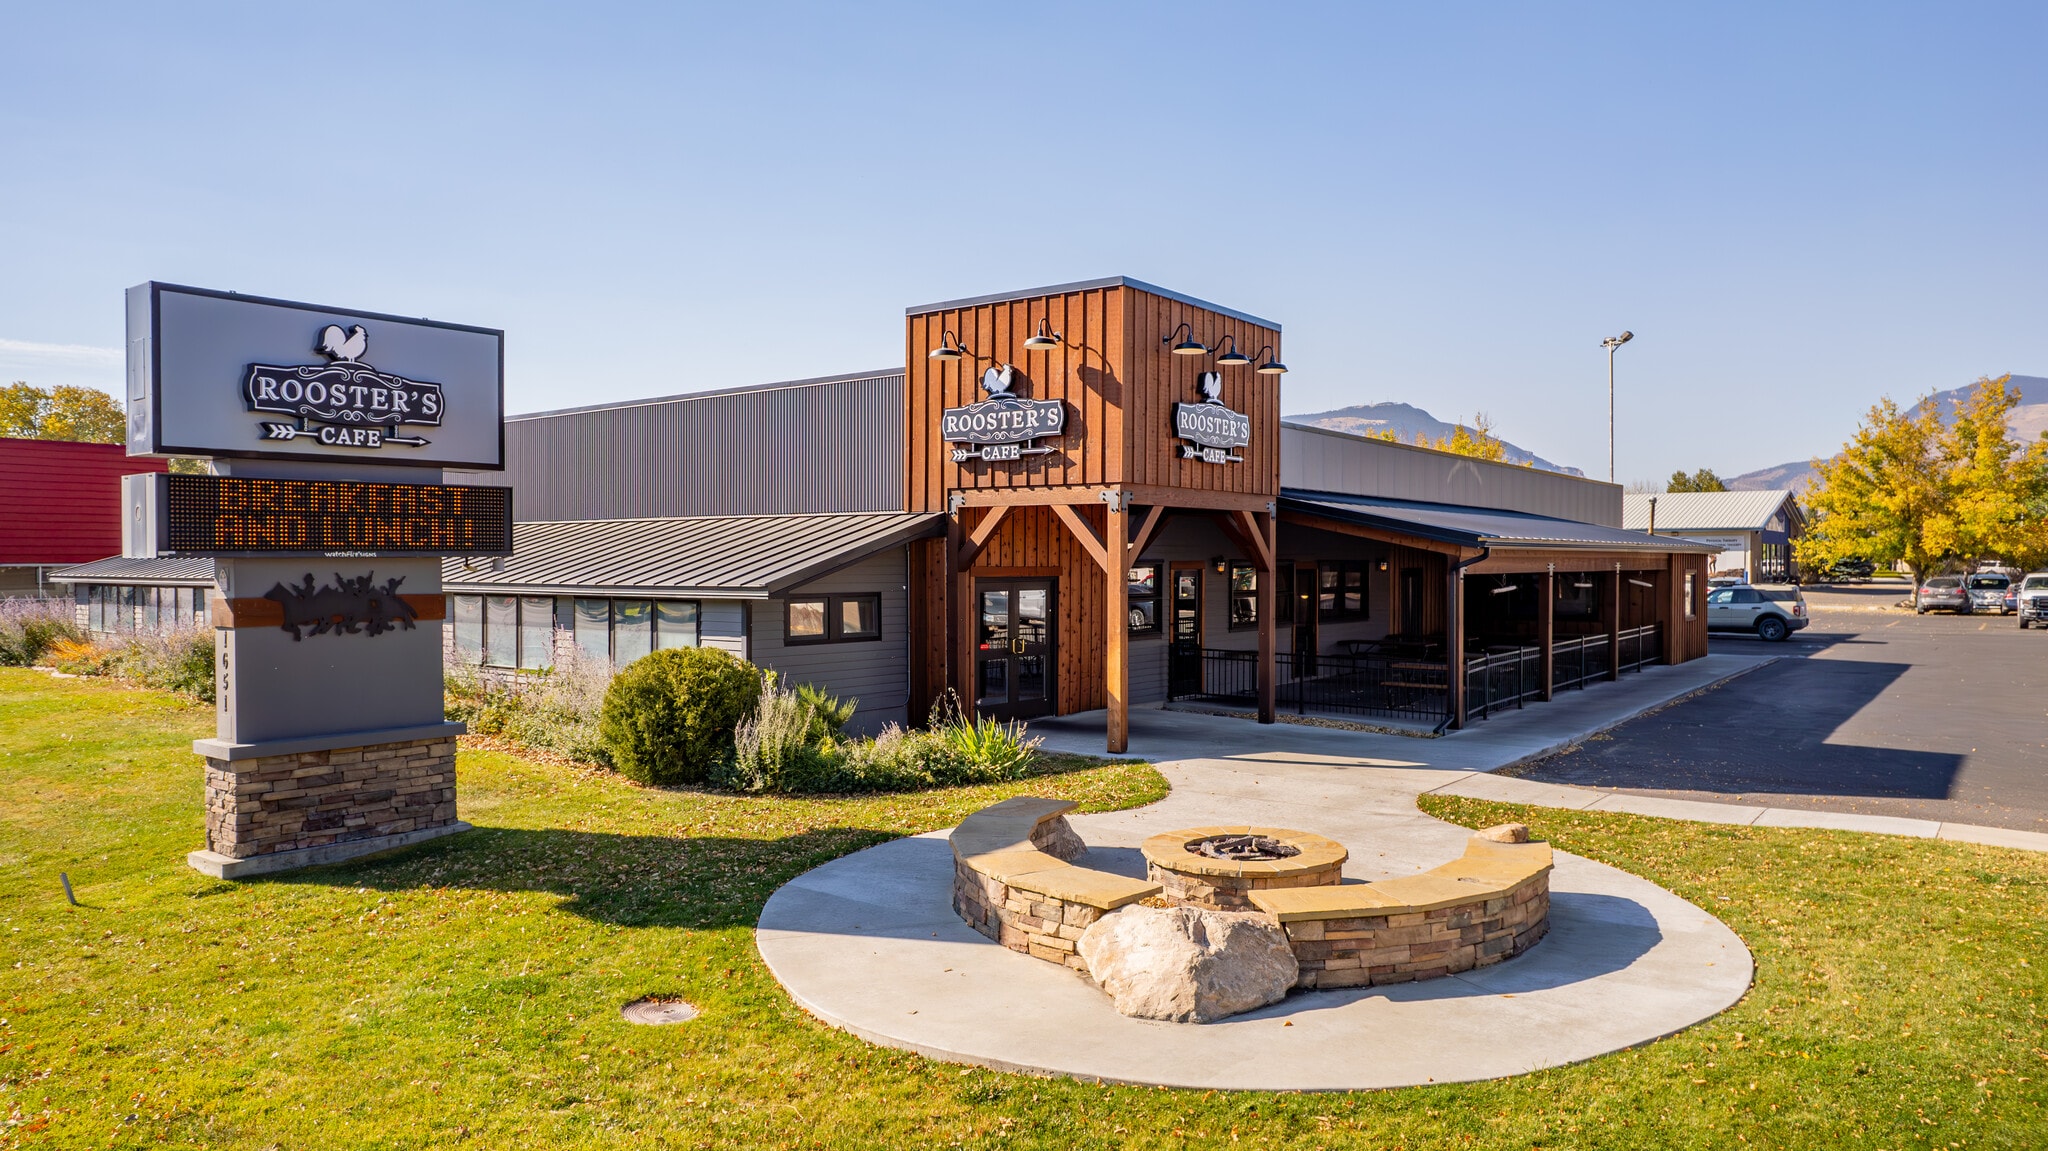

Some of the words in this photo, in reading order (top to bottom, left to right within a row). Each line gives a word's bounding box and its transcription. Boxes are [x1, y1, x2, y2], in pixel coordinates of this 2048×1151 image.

[257, 376, 438, 415] ROOSTER'S
[946, 407, 1059, 433] ROOSTER'S
[1180, 411, 1248, 438] ROOSTER'S
[321, 427, 381, 447] CAFE
[981, 445, 1020, 460] CAFE
[1203, 448, 1226, 463] CAFE
[219, 479, 469, 515] BREAKFAST
[215, 514, 307, 546] AND
[323, 516, 475, 547] LUNCH!
